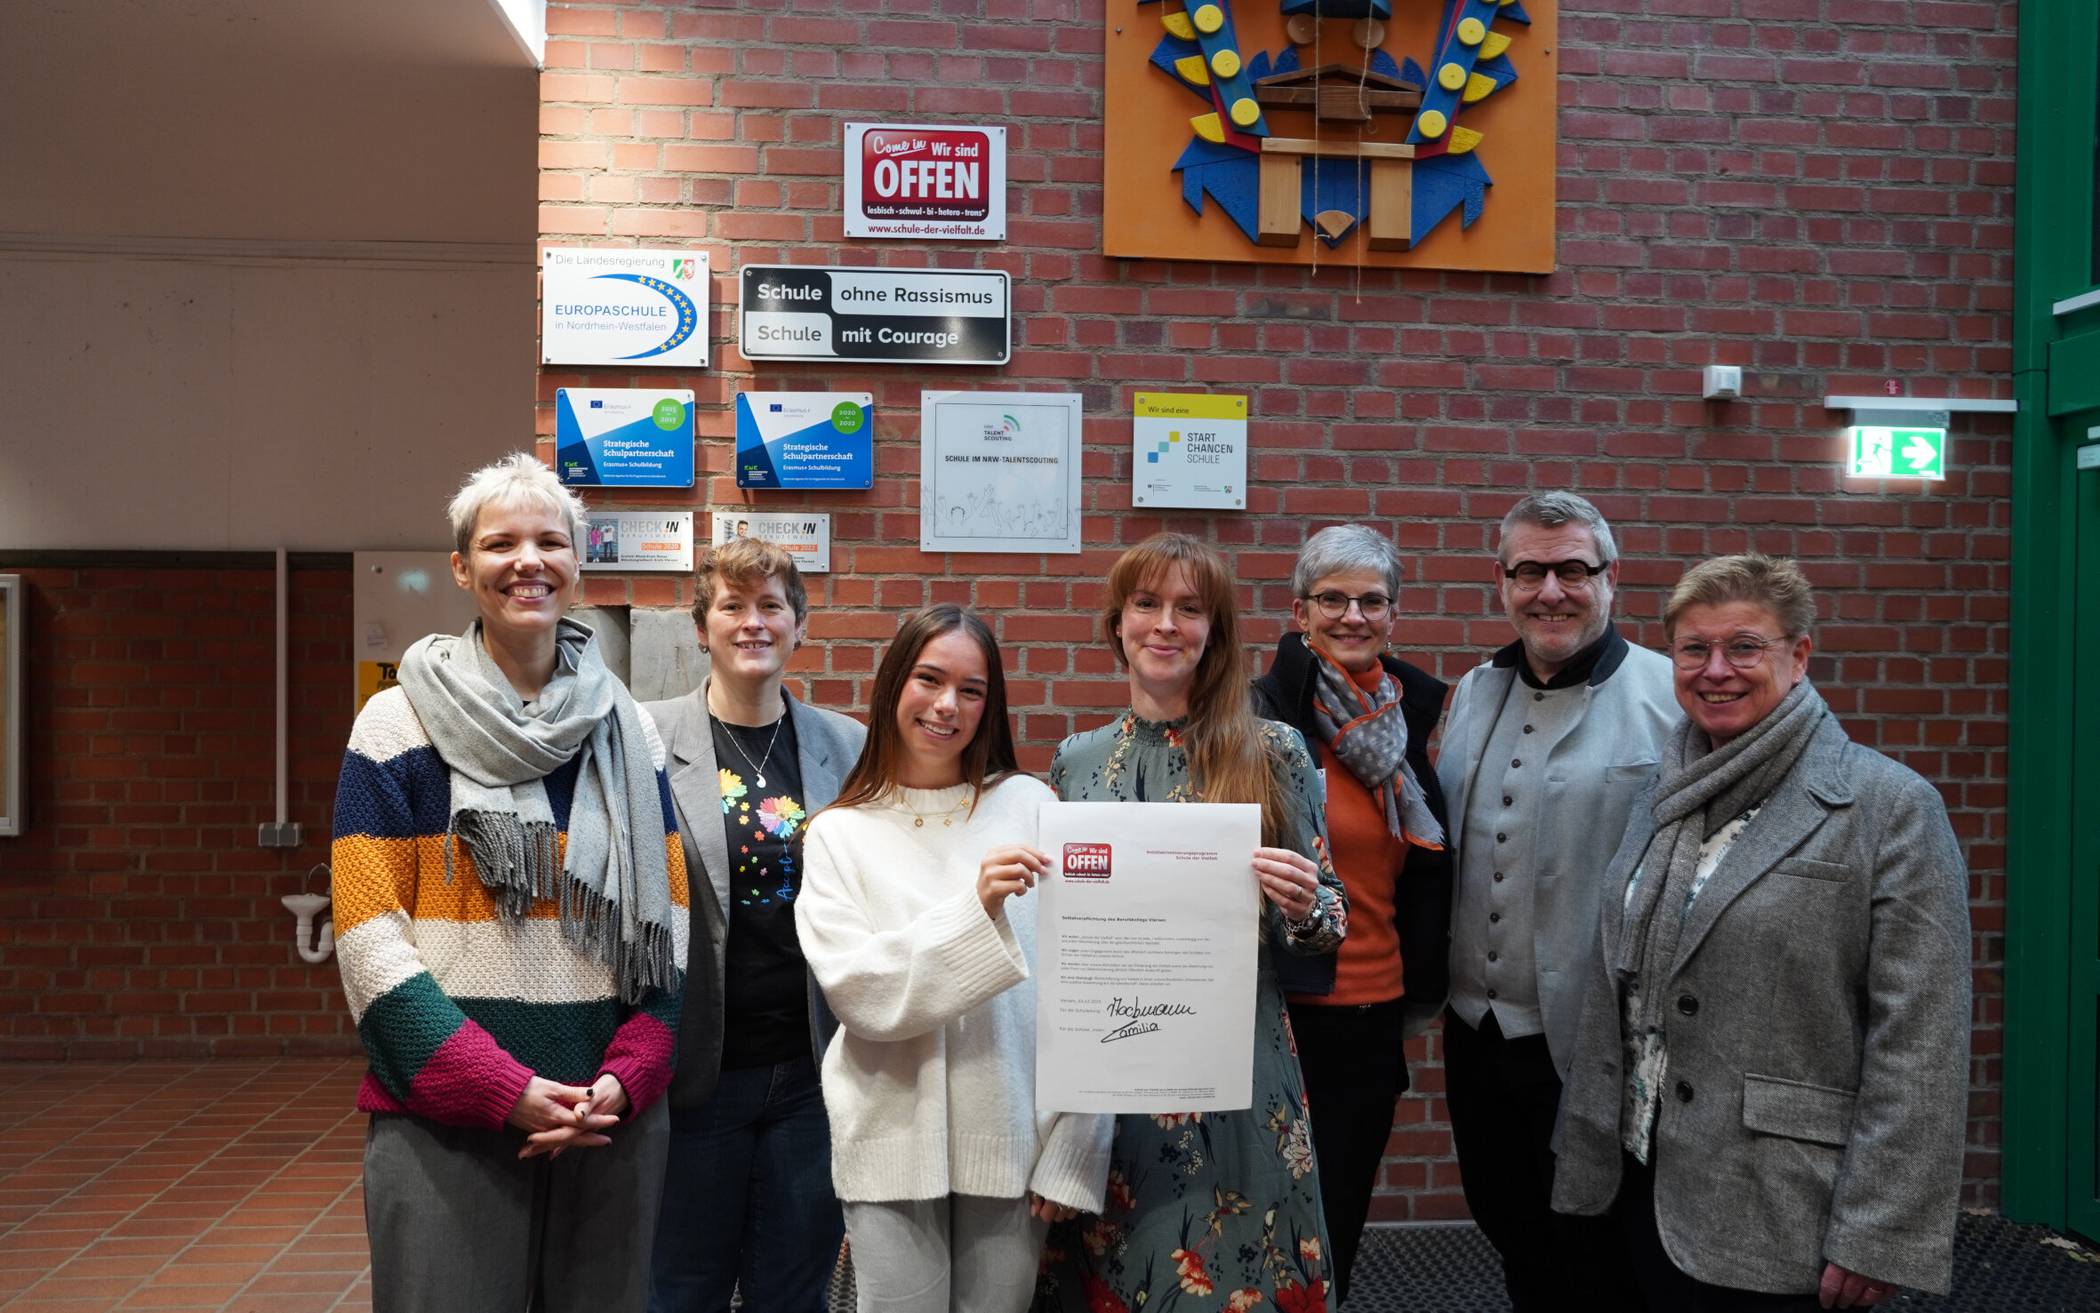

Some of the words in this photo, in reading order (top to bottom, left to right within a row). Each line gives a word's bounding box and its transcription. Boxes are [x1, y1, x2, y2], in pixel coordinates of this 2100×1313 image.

[873, 136, 910, 154] Come
[912, 138, 927, 151] in
[931, 142, 952, 156] Wir
[954, 143, 978, 157] sind
[873, 158, 980, 199] OFFEN
[867, 205, 895, 215] lesbisch
[899, 206, 922, 216] schwul
[926, 206, 934, 216] bi
[938, 207, 960, 216] hetero
[868, 223, 985, 235] www.schule-der-vielfalt.de
[555, 254, 573, 265] Die
[577, 255, 665, 268] Landesregierung
[757, 283, 823, 300] Schule
[840, 287, 887, 302] ohne
[894, 287, 993, 304] Rassismus
[555, 304, 667, 317] EUROPASCHULE
[555, 321, 564, 330] in
[567, 321, 666, 332] Nordrhein-Westfalen
[757, 325, 822, 341] Schule
[842, 327, 872, 343] mit
[877, 328, 959, 348] Courage
[1187, 432, 1216, 442] START
[603, 440, 649, 449] Strategische
[783, 443, 828, 452] Strategische
[1187, 443, 1233, 454] CHANCEN
[603, 449, 674, 458] Schulpartnerschaft
[783, 452, 853, 462] Schulpartnerschaft
[1186, 454, 1220, 464] SCHULE
[621, 520, 662, 533] CHECK
[759, 521, 800, 534] CHECK
[1067, 854, 1108, 870] OFFEN
